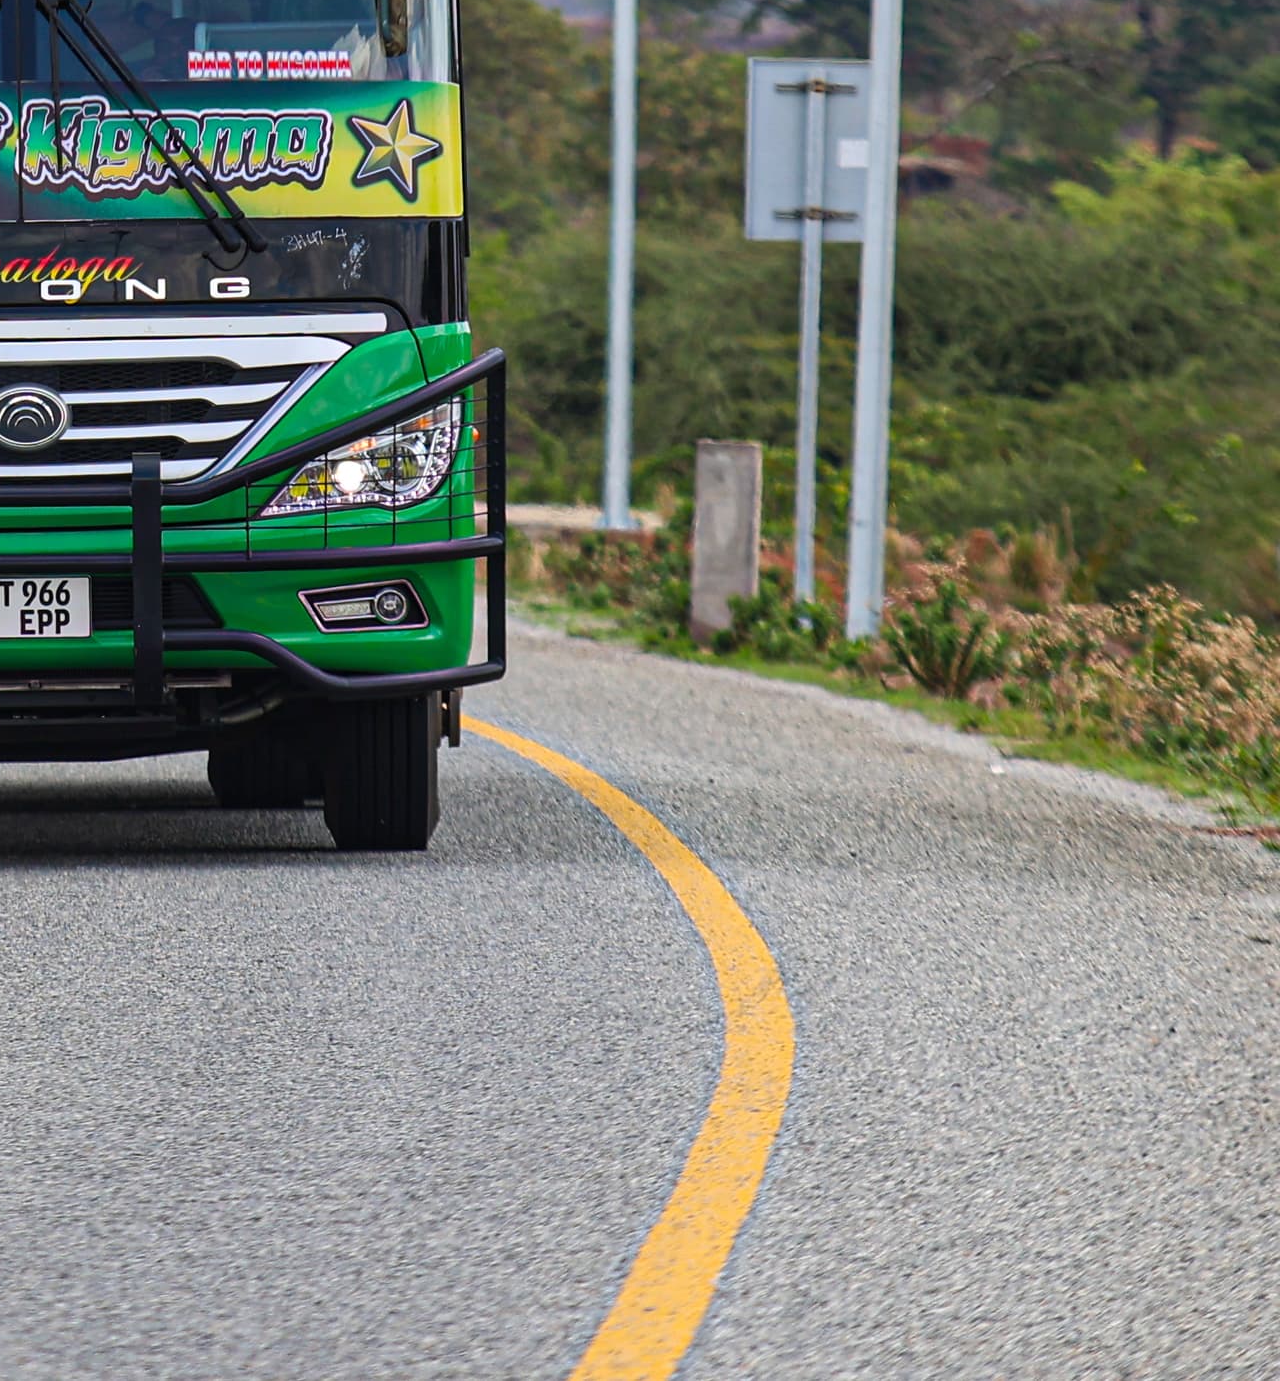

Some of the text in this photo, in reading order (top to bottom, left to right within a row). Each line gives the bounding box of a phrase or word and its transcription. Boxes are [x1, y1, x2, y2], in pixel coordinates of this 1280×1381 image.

[188, 50, 352, 80] DAR TO KIGOMA
[16, 96, 330, 192] Kigoma
[22, 580, 71, 607] 966
[20, 609, 71, 635] EPP
